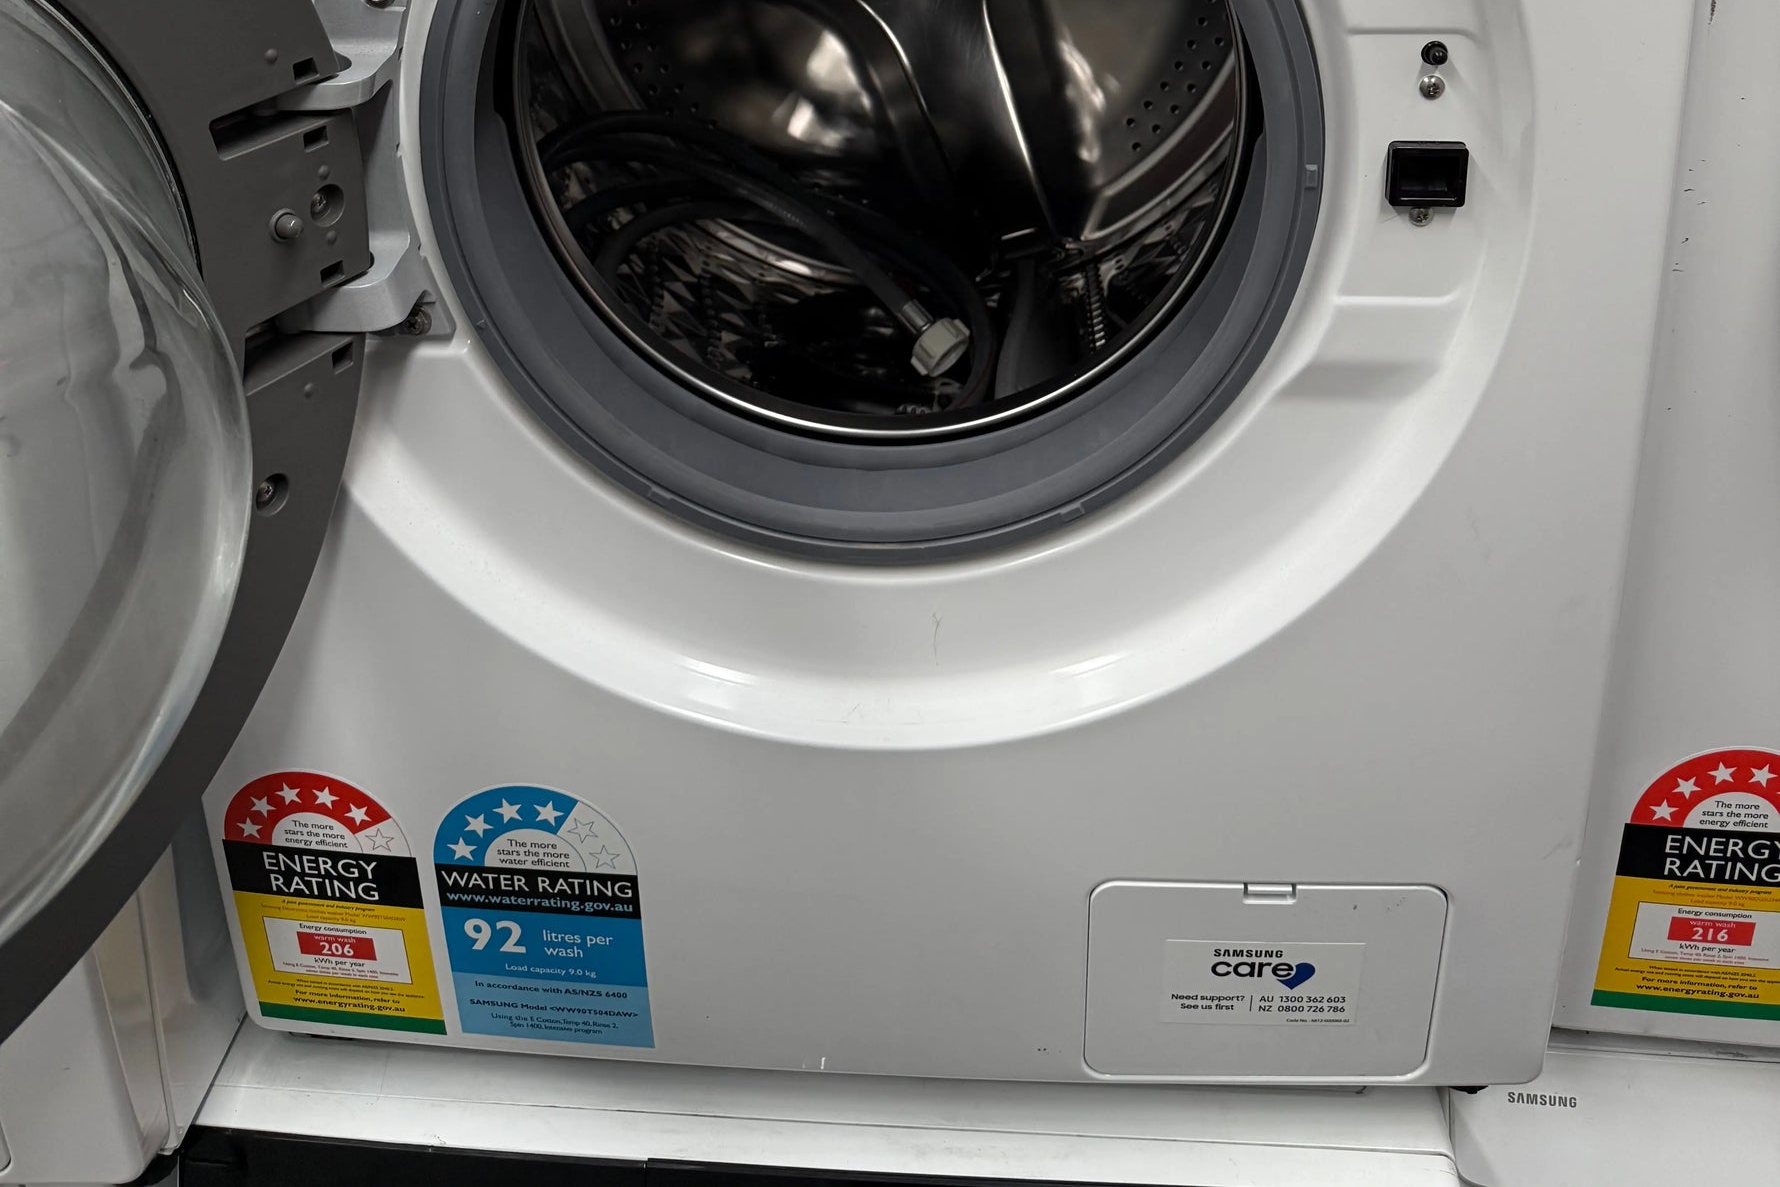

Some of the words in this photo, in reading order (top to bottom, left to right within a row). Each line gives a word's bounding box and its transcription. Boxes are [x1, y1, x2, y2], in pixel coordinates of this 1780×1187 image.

[1714, 800, 1732, 810] The
[1702, 810, 1724, 818] stars
[1726, 810, 1742, 819] the
[1744, 812, 1769, 820] more
[292, 820, 308, 828] The
[1700, 818, 1730, 828] energy
[1733, 819, 1768, 828] efficient
[284, 828, 304, 837] stars
[307, 830, 320, 838] the
[322, 832, 346, 840] more
[284, 838, 312, 846] energy
[316, 839, 348, 848] efficient
[507, 838, 527, 848] The
[530, 841, 558, 850] more
[496, 848, 520, 857] stars
[523, 849, 540, 858] the
[542, 852, 570, 860] more
[262, 851, 378, 880] ENERGY
[498, 858, 529, 866] water
[531, 858, 570, 868] efficient
[1663, 858, 1780, 882] RATING
[270, 874, 380, 901] RATING
[441, 870, 530, 892] WATER
[537, 876, 633, 898] RATING
[446, 892, 633, 912] www.waterrating.gov.au
[1678, 908, 1702, 917] Energy
[1704, 911, 1752, 919] consumption
[300, 922, 322, 932] Energy
[324, 926, 367, 936] consumption
[1715, 921, 1736, 929] wash
[314, 934, 336, 942] warm
[338, 936, 356, 944] wash
[463, 918, 527, 954] 92
[542, 930, 581, 944] litres
[586, 934, 613, 948] per
[1692, 927, 1729, 942] 216
[320, 942, 354, 956] 206
[544, 946, 584, 958] wash
[1213, 948, 1284, 958] SAMSUNG
[1680, 943, 1700, 952] kWh
[1702, 946, 1716, 954] per
[314, 958, 333, 966] kWh
[334, 960, 348, 968] per
[505, 963, 528, 972] Load
[530, 965, 566, 976] capacity
[568, 968, 583, 976] 9.0
[586, 970, 597, 978] kg
[1210, 961, 1294, 978] care
[486, 982, 540, 992] accordance
[542, 986, 562, 994] with
[564, 988, 603, 997] AS/NZS
[1680, 980, 1727, 989] information,
[1636, 984, 1760, 999] www.energyrating.gov.au
[1200, 994, 1245, 1002] support?
[1306, 996, 1324, 1004] 362
[1326, 996, 1346, 1004] 603
[293, 997, 406, 1012] www.energyrating.gov.au
[470, 998, 518, 1009] SAMSUNG
[520, 1003, 548, 1011] Model
[1180, 1002, 1199, 1010] See
[1278, 1005, 1304, 1013] 0800
[1306, 1005, 1325, 1013] 726
[1327, 1005, 1346, 1013] 786
[491, 1012, 514, 1021] Using
[1508, 1091, 1578, 1108] SAMSUNG
